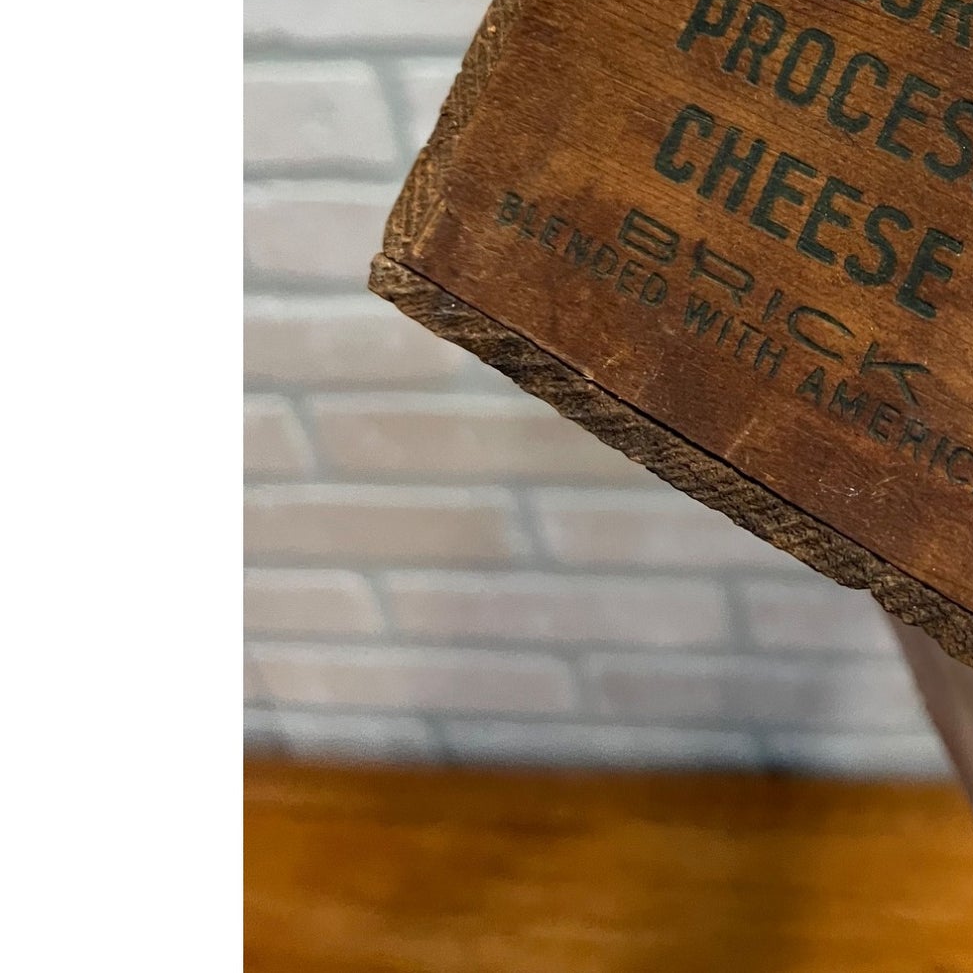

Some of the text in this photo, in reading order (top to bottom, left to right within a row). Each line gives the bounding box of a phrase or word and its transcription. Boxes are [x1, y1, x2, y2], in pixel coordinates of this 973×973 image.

[497, 191, 668, 308] BLENDED
[683, 292, 790, 380] WITH
[653, 104, 964, 320] CHEESE
